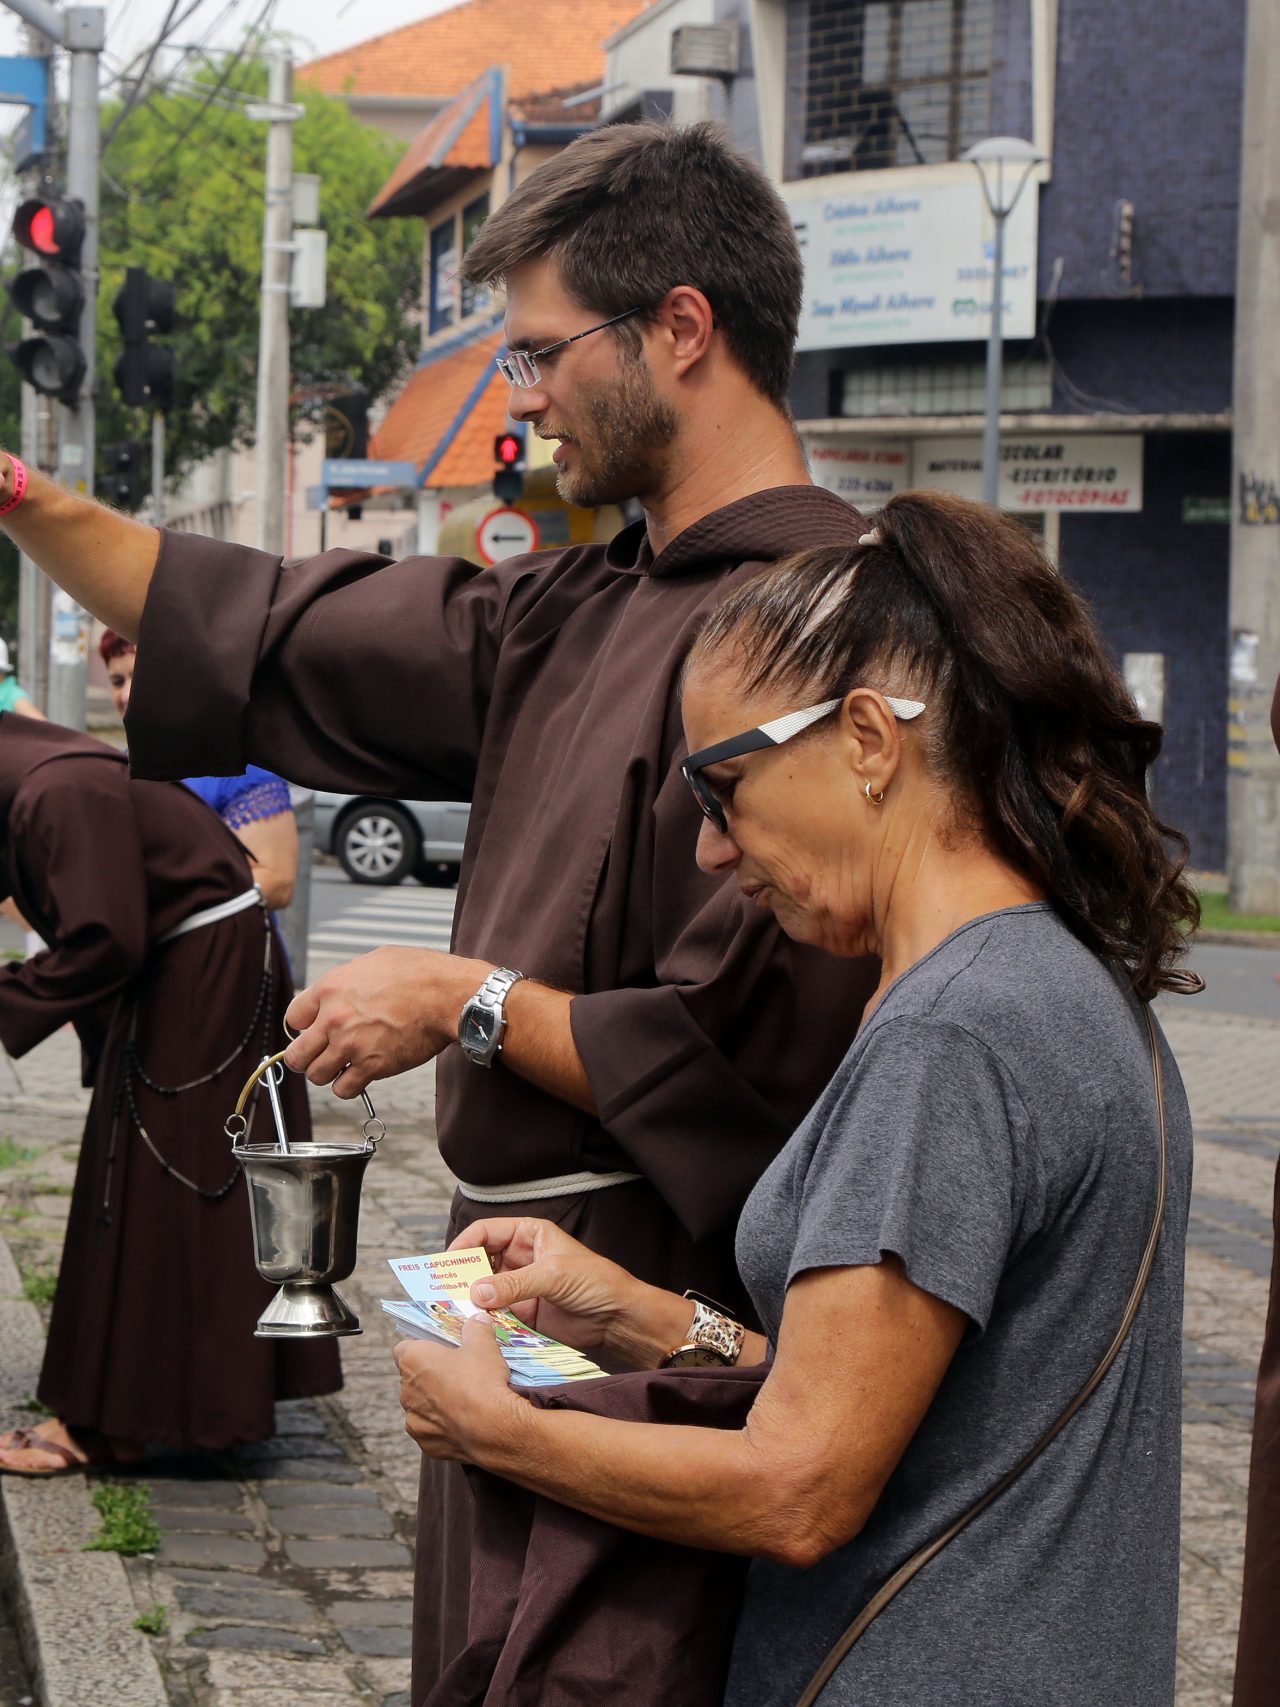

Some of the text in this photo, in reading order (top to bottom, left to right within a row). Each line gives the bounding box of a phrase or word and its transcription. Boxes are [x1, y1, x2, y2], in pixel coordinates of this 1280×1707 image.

[398, 1255, 482, 1271] FREIS CAPUCHINHOS
[430, 1271, 458, 1280] Mercês
[430, 1281, 470, 1291] Curitiba-PR
